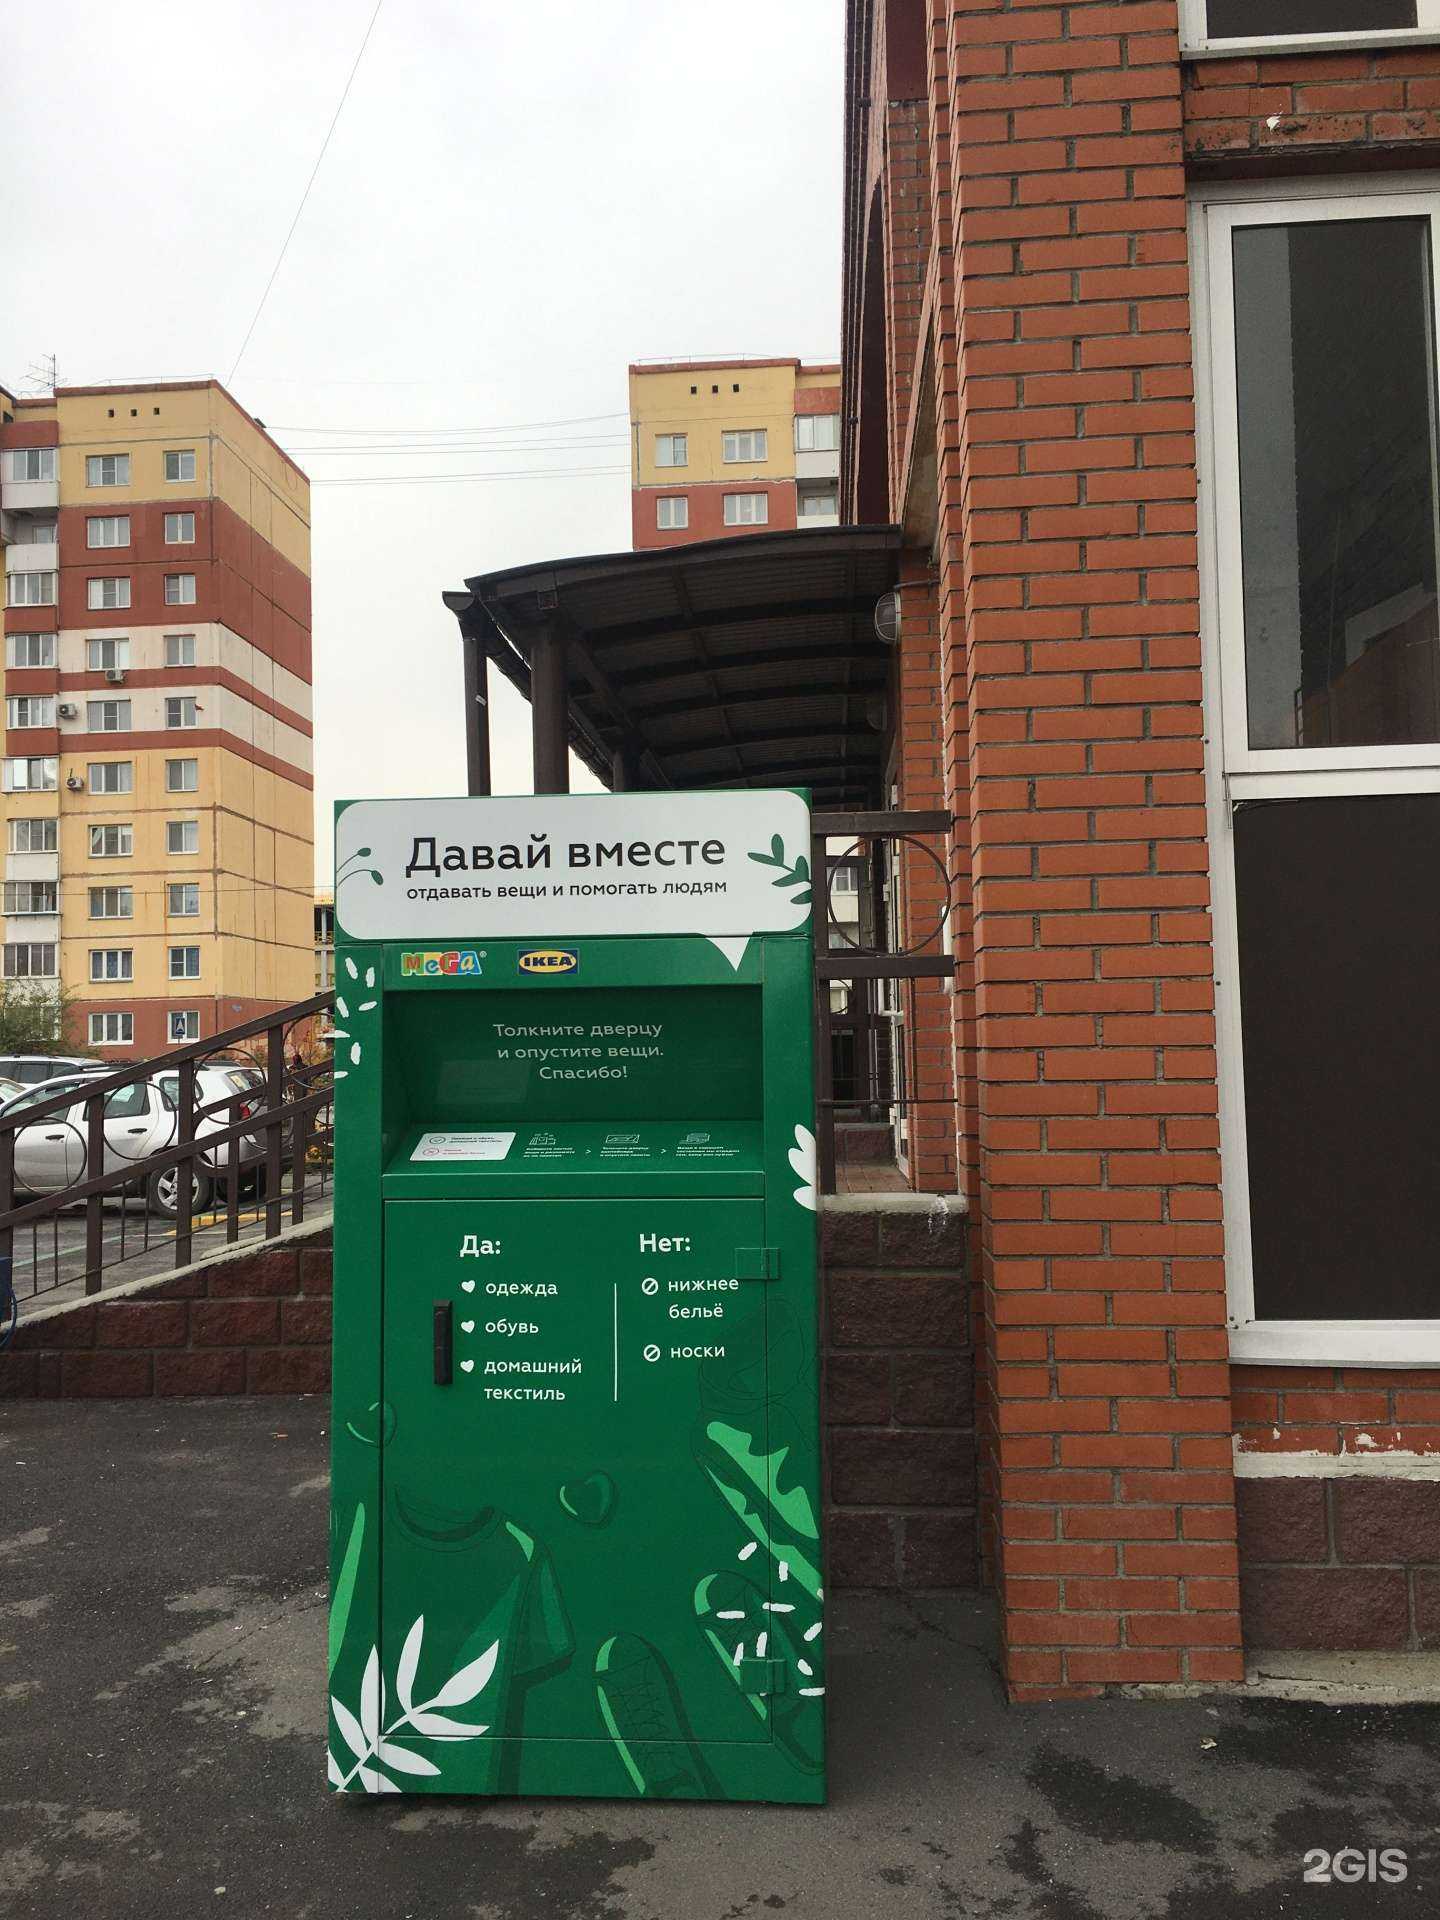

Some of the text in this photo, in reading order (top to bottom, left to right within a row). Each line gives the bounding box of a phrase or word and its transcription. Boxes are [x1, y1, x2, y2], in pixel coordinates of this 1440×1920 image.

[405, 833, 725, 878] Давай вместе
[406, 882, 727, 901] отдавать вещи и помогать людям
[492, 1024, 663, 1038] Толкните дверцу
[498, 1046, 664, 1061] и опустите вещи.
[539, 1066, 628, 1079] Спасибо!
[460, 1234, 501, 1258] Да:
[639, 1233, 691, 1252] Нет:
[485, 1282, 558, 1296] одежда
[668, 1278, 739, 1292] нижнее
[669, 1304, 724, 1318] бельё
[485, 1318, 539, 1337] обувь
[670, 1345, 725, 1358] носки
[484, 1358, 582, 1375] домашний
[484, 1386, 565, 1400] текстиль
